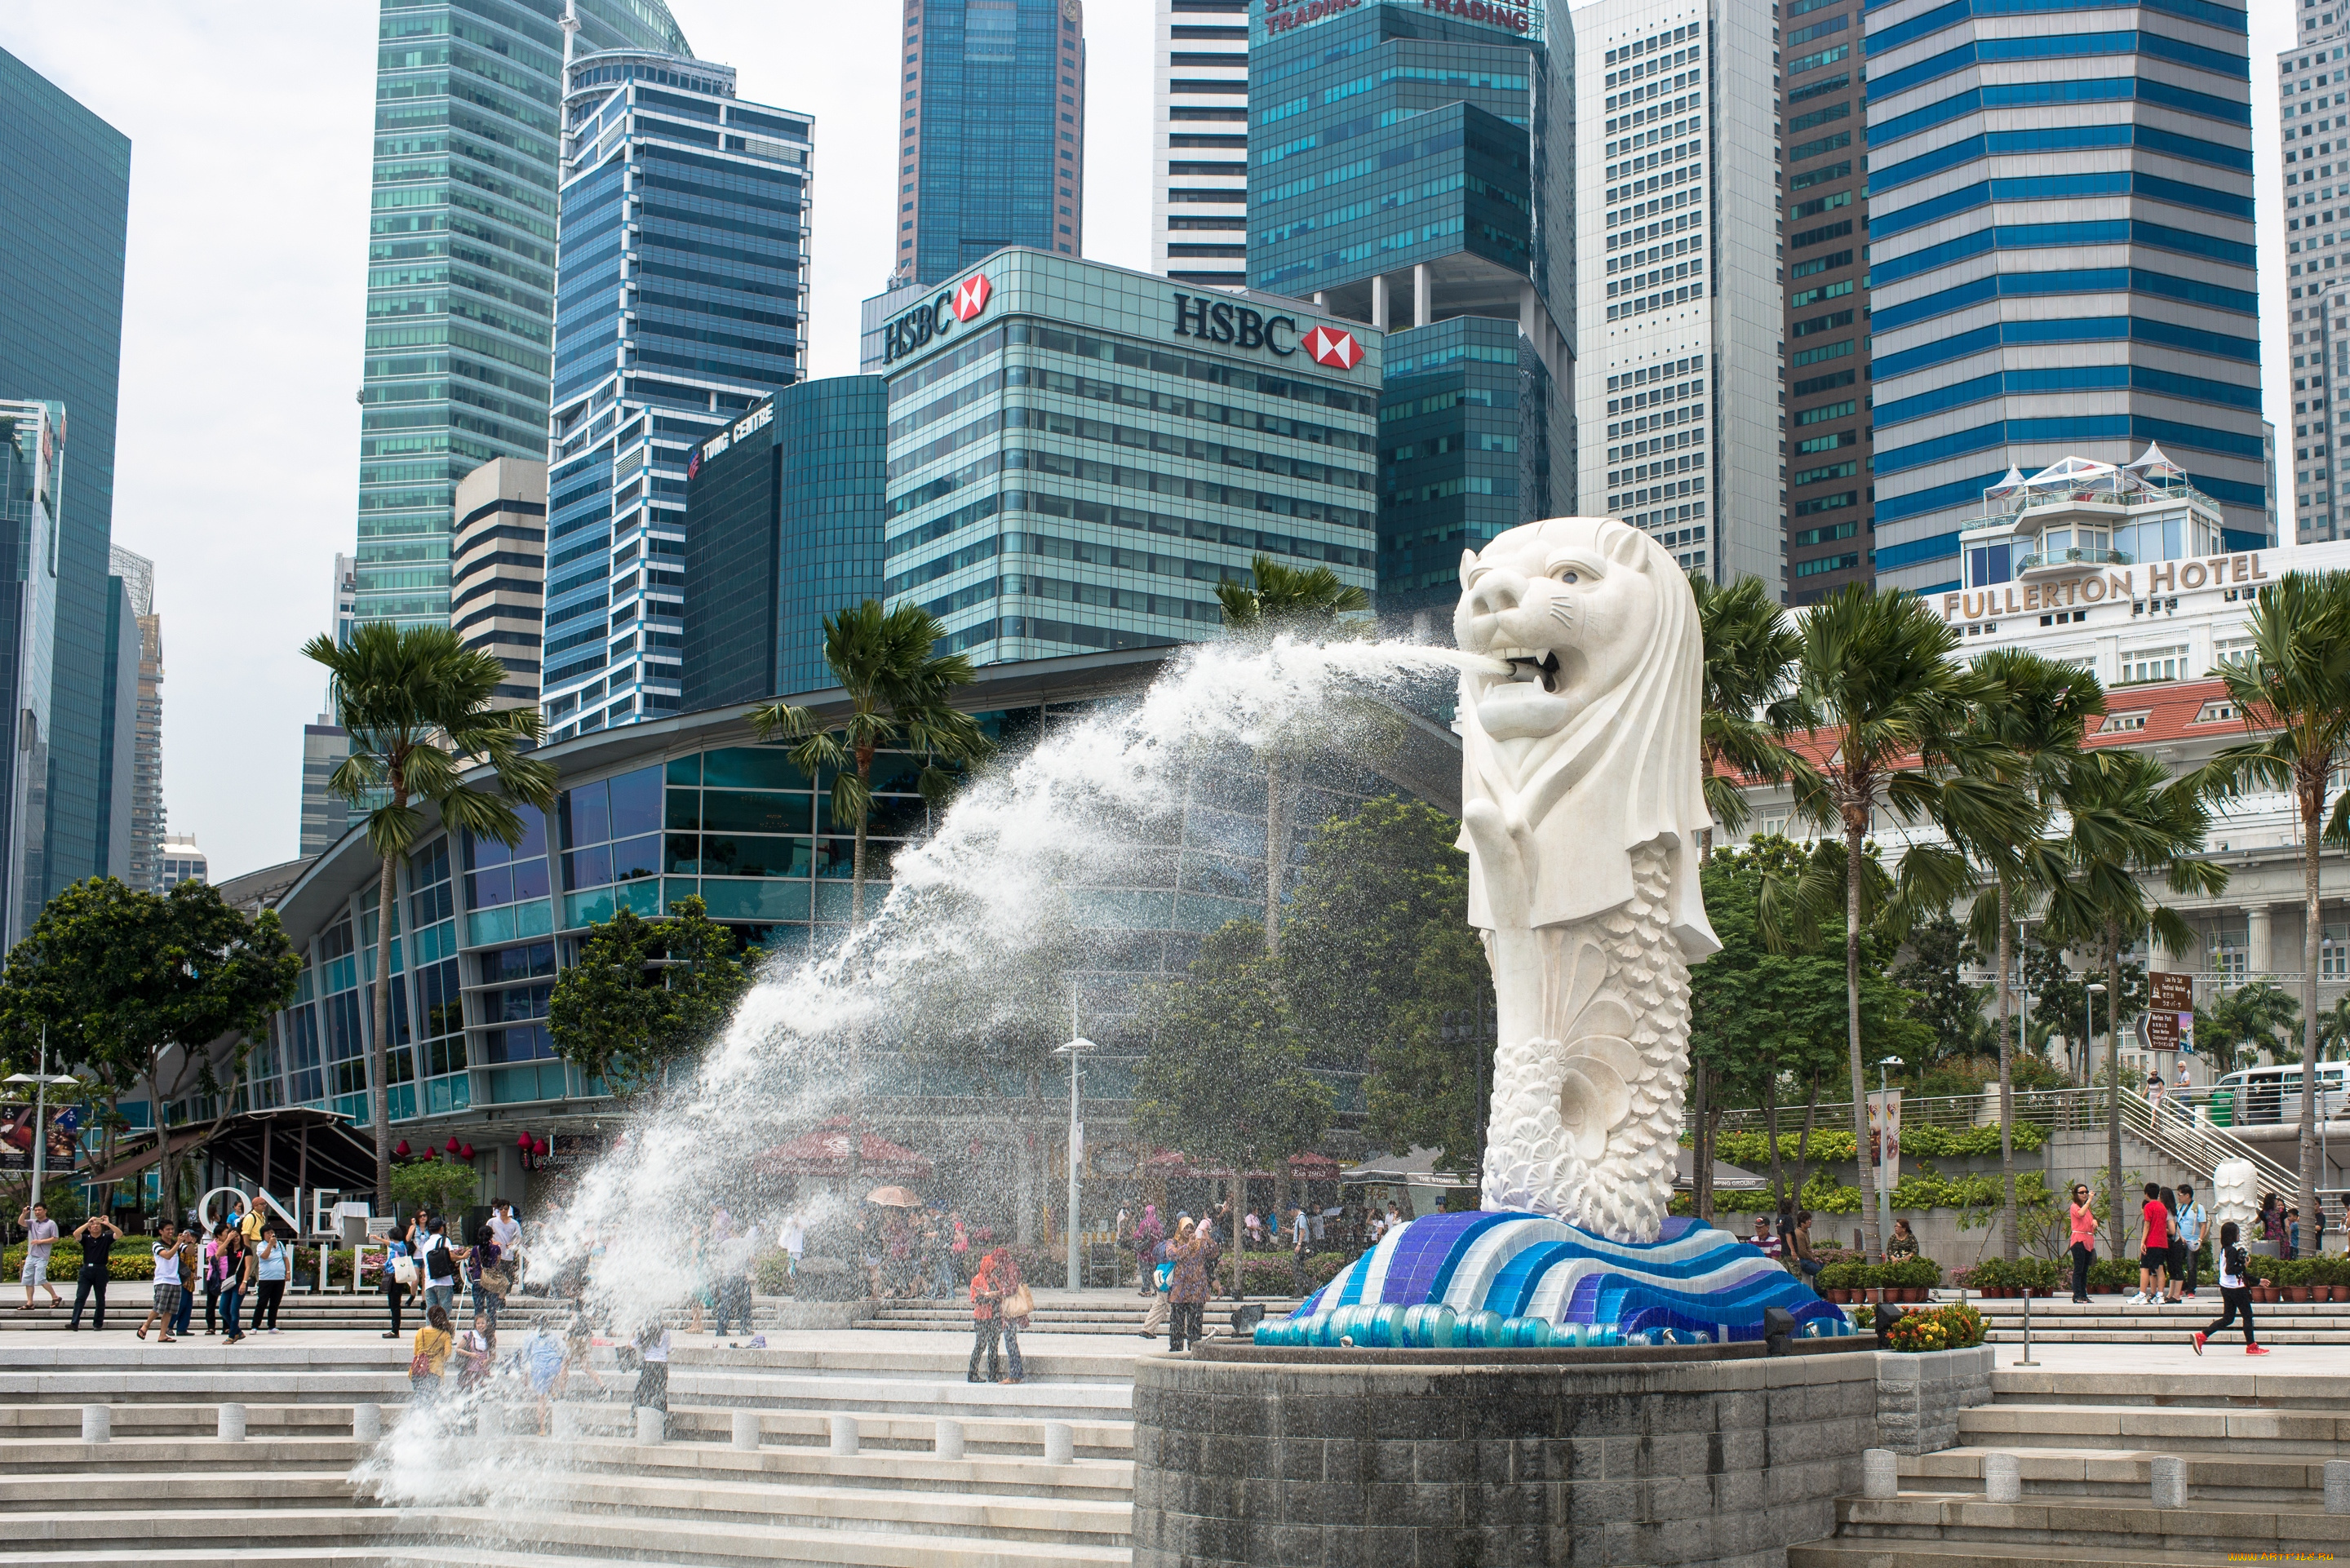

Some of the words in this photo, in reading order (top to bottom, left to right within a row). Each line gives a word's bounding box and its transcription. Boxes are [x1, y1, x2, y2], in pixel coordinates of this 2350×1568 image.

[883, 290, 951, 365] HSBC
[1173, 293, 1296, 356] HSBC
[703, 432, 729, 462] TUNG
[733, 402, 774, 443] CENTRE
[1944, 570, 2132, 621] FULLERTON
[2149, 553, 2268, 593] HOTEL
[1307, 1169, 1326, 1177] 1963
[198, 1186, 340, 1234] ONE
